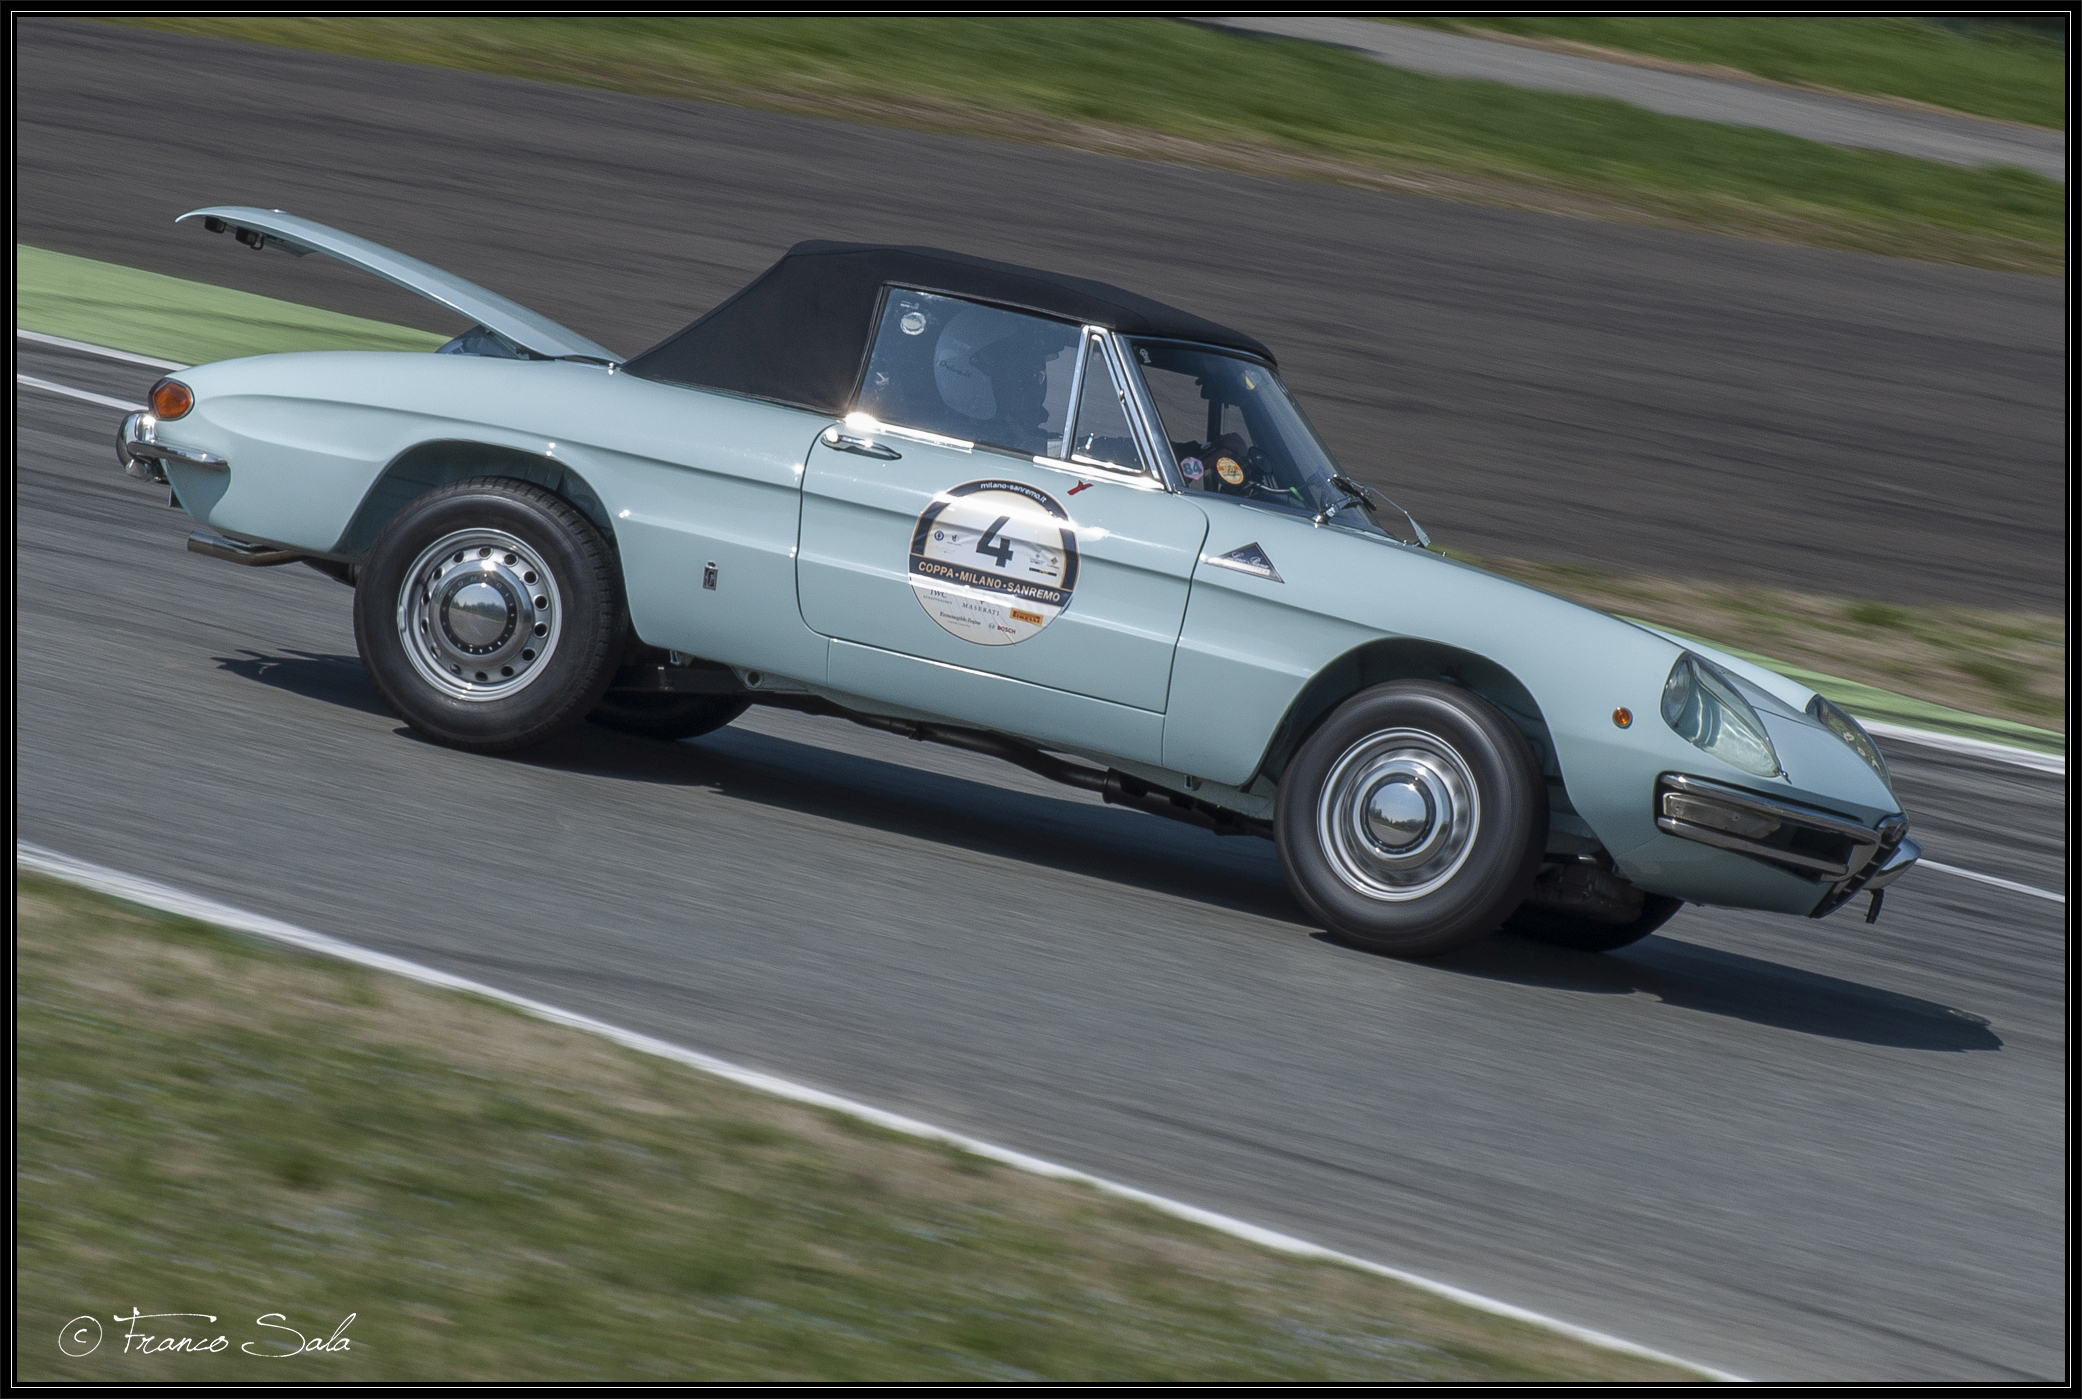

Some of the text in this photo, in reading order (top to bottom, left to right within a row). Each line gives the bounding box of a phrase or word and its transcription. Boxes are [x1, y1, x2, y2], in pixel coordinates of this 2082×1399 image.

[1183, 461, 1202, 476] 84
[980, 482, 1047, 503] milano-sanremo.it
[976, 515, 1013, 568] 4
[918, 561, 1061, 602] COPPA MILANO SANREMO
[962, 602, 1000, 616] MASERATI
[997, 625, 1016, 635] BOSCH
